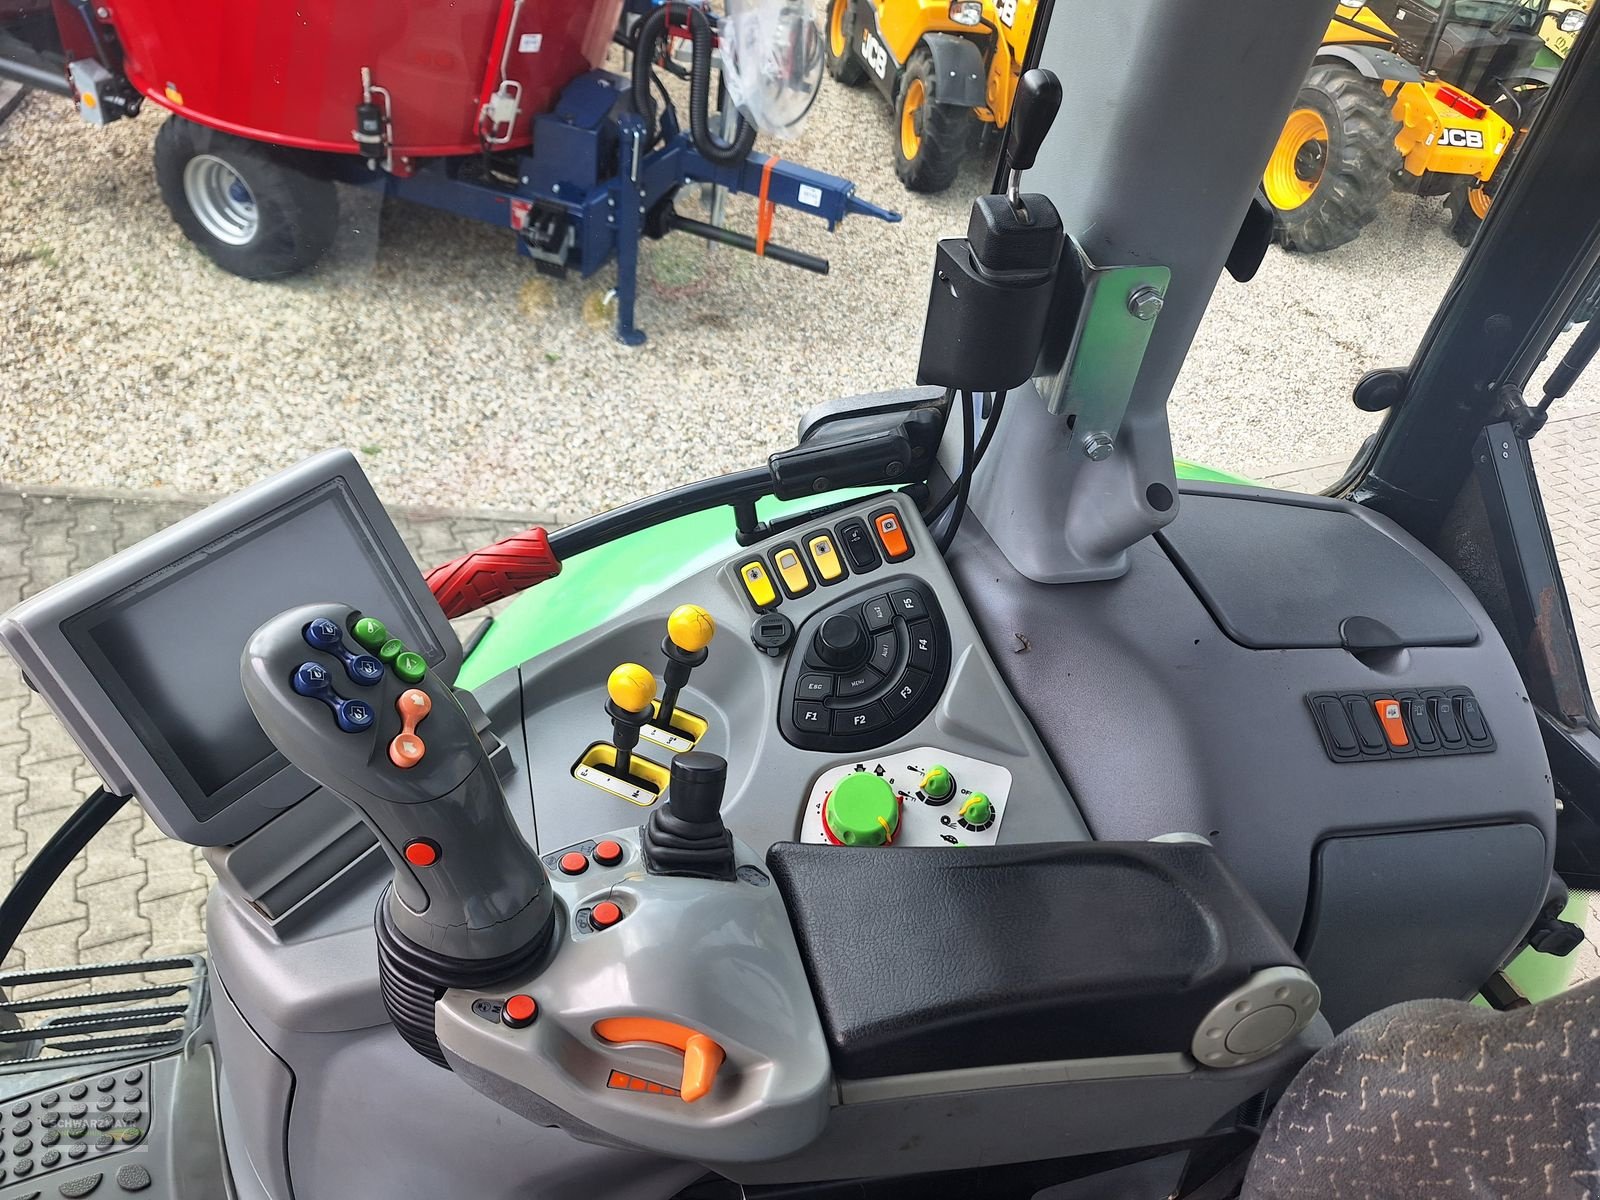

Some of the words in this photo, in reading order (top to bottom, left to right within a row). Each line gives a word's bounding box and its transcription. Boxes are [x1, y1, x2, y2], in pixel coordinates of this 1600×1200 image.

[861, 29, 888, 80] JCB
[1437, 128, 1483, 148] JCB
[903, 598, 914, 609] F5
[919, 639, 928, 651] F4
[900, 686, 912, 699] F3
[805, 711, 818, 721] F1
[854, 715, 867, 726] F2
